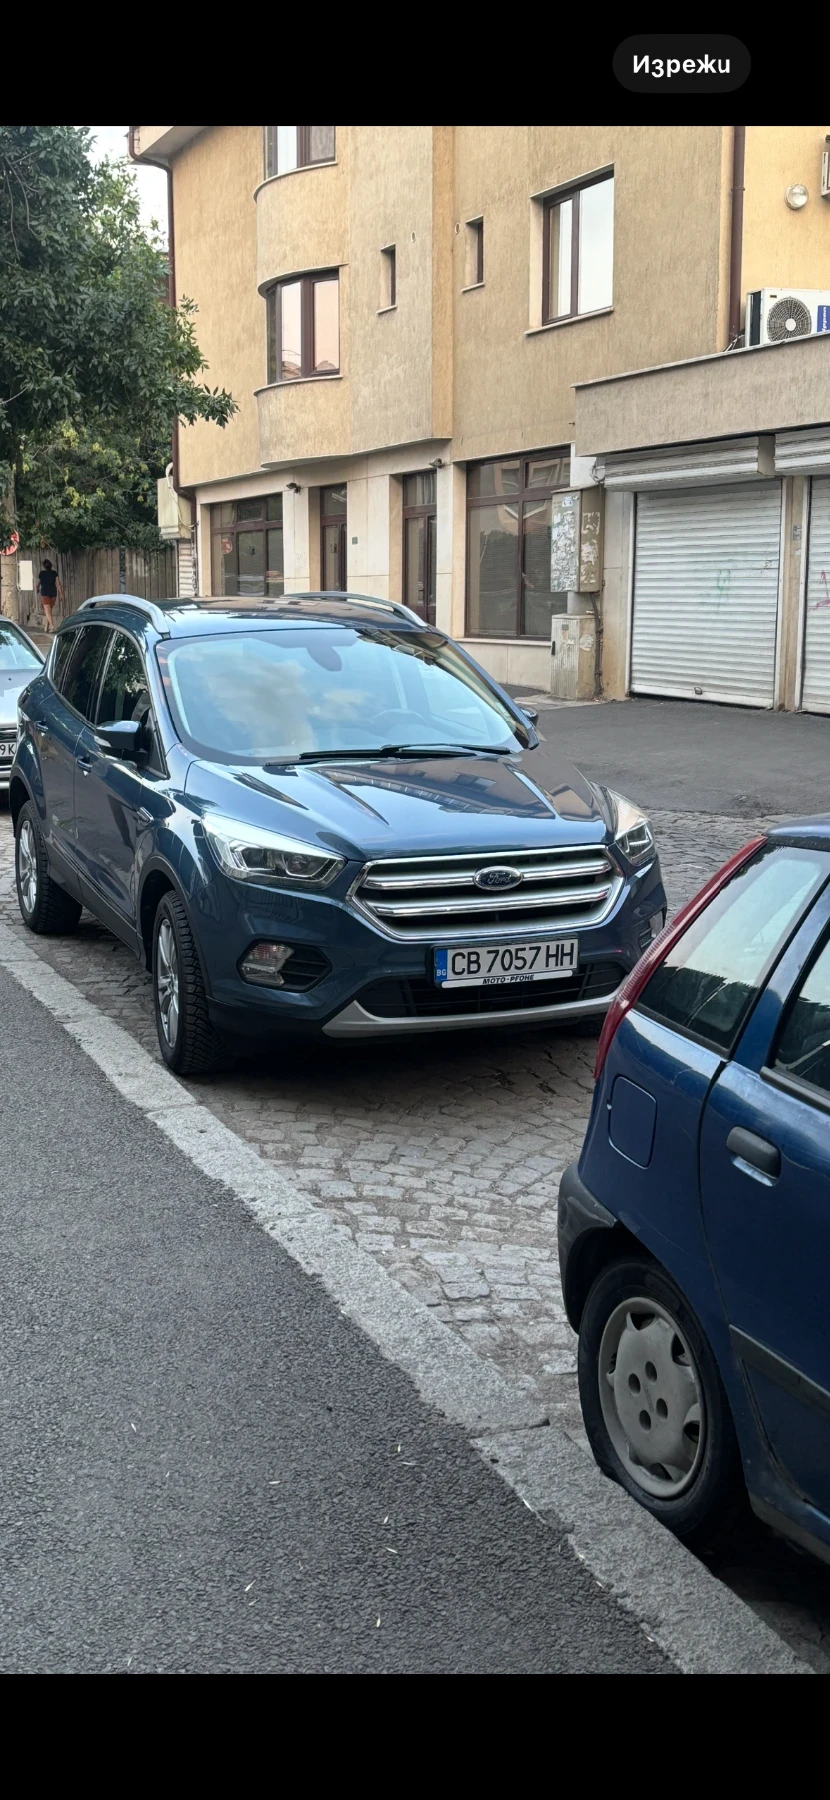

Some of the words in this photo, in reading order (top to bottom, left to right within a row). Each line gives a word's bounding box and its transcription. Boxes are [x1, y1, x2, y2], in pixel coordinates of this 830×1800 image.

[487, 872, 512, 885] Ford
[451, 951, 481, 976] CB
[486, 946, 542, 973] 7057
[545, 942, 575, 968] HH
[436, 969, 447, 977] BG
